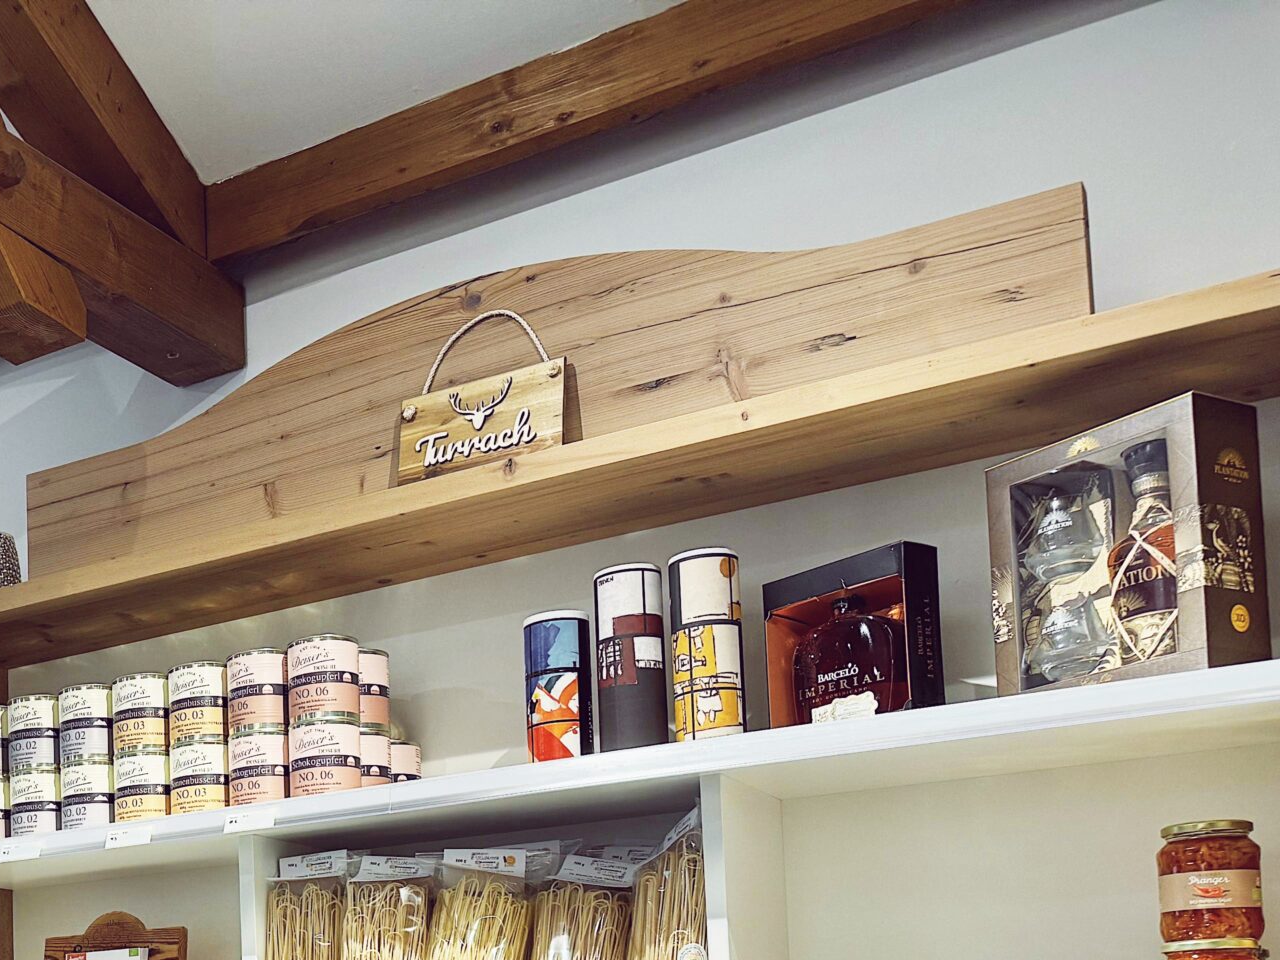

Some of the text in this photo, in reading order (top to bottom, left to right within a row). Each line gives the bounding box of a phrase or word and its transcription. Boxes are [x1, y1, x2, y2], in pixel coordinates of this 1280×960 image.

[415, 407, 537, 467] Turrach
[292, 649, 330, 670] Deiser's
[817, 665, 859, 683] BARCELÓ
[290, 673, 340, 687] Schokogupferl
[316, 686, 329, 696] 06
[799, 671, 885, 701] IMPERIAL
[238, 701, 249, 711] 06
[192, 710, 205, 720] 03
[133, 721, 145, 730] 03
[75, 731, 86, 740] 02
[26, 740, 37, 750] 02
[295, 733, 335, 752] Deiser's
[292, 757, 345, 769] Schokogupferl
[320, 769, 334, 780] 06
[248, 780, 261, 790] 06
[194, 788, 207, 798] 03
[132, 798, 144, 807] 03
[76, 807, 87, 816] 02
[27, 814, 38, 823] 02
